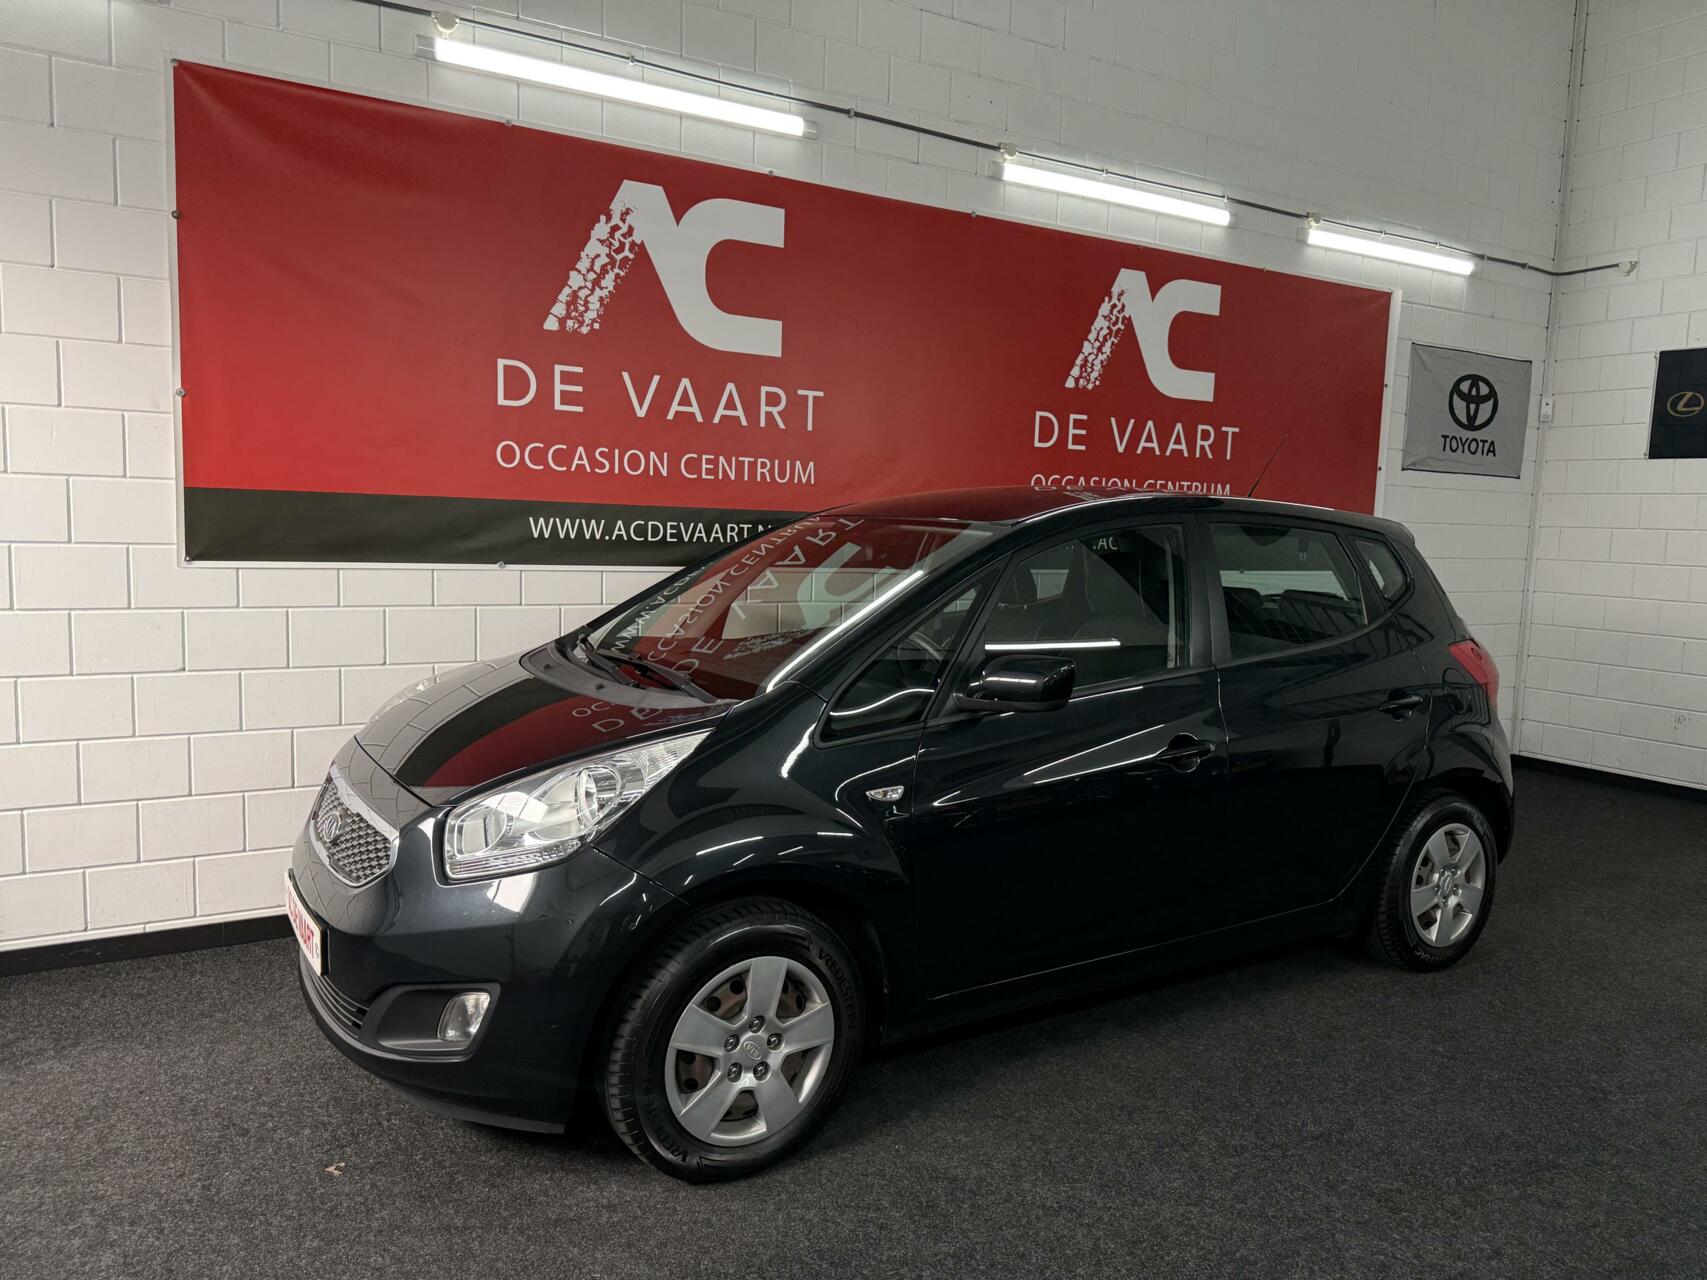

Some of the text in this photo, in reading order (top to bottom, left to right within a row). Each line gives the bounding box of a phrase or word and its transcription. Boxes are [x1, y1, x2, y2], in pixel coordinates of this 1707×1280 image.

[543, 179, 785, 358] AC
[1065, 268, 1221, 402] AC
[496, 358, 824, 431] DE VAART
[1033, 410, 1239, 460] DE VAART
[1441, 434, 1497, 457] TOYOTA
[495, 440, 815, 484] OCCASION CENTRUM
[529, 516, 769, 544] WWW.ACDEVAART
